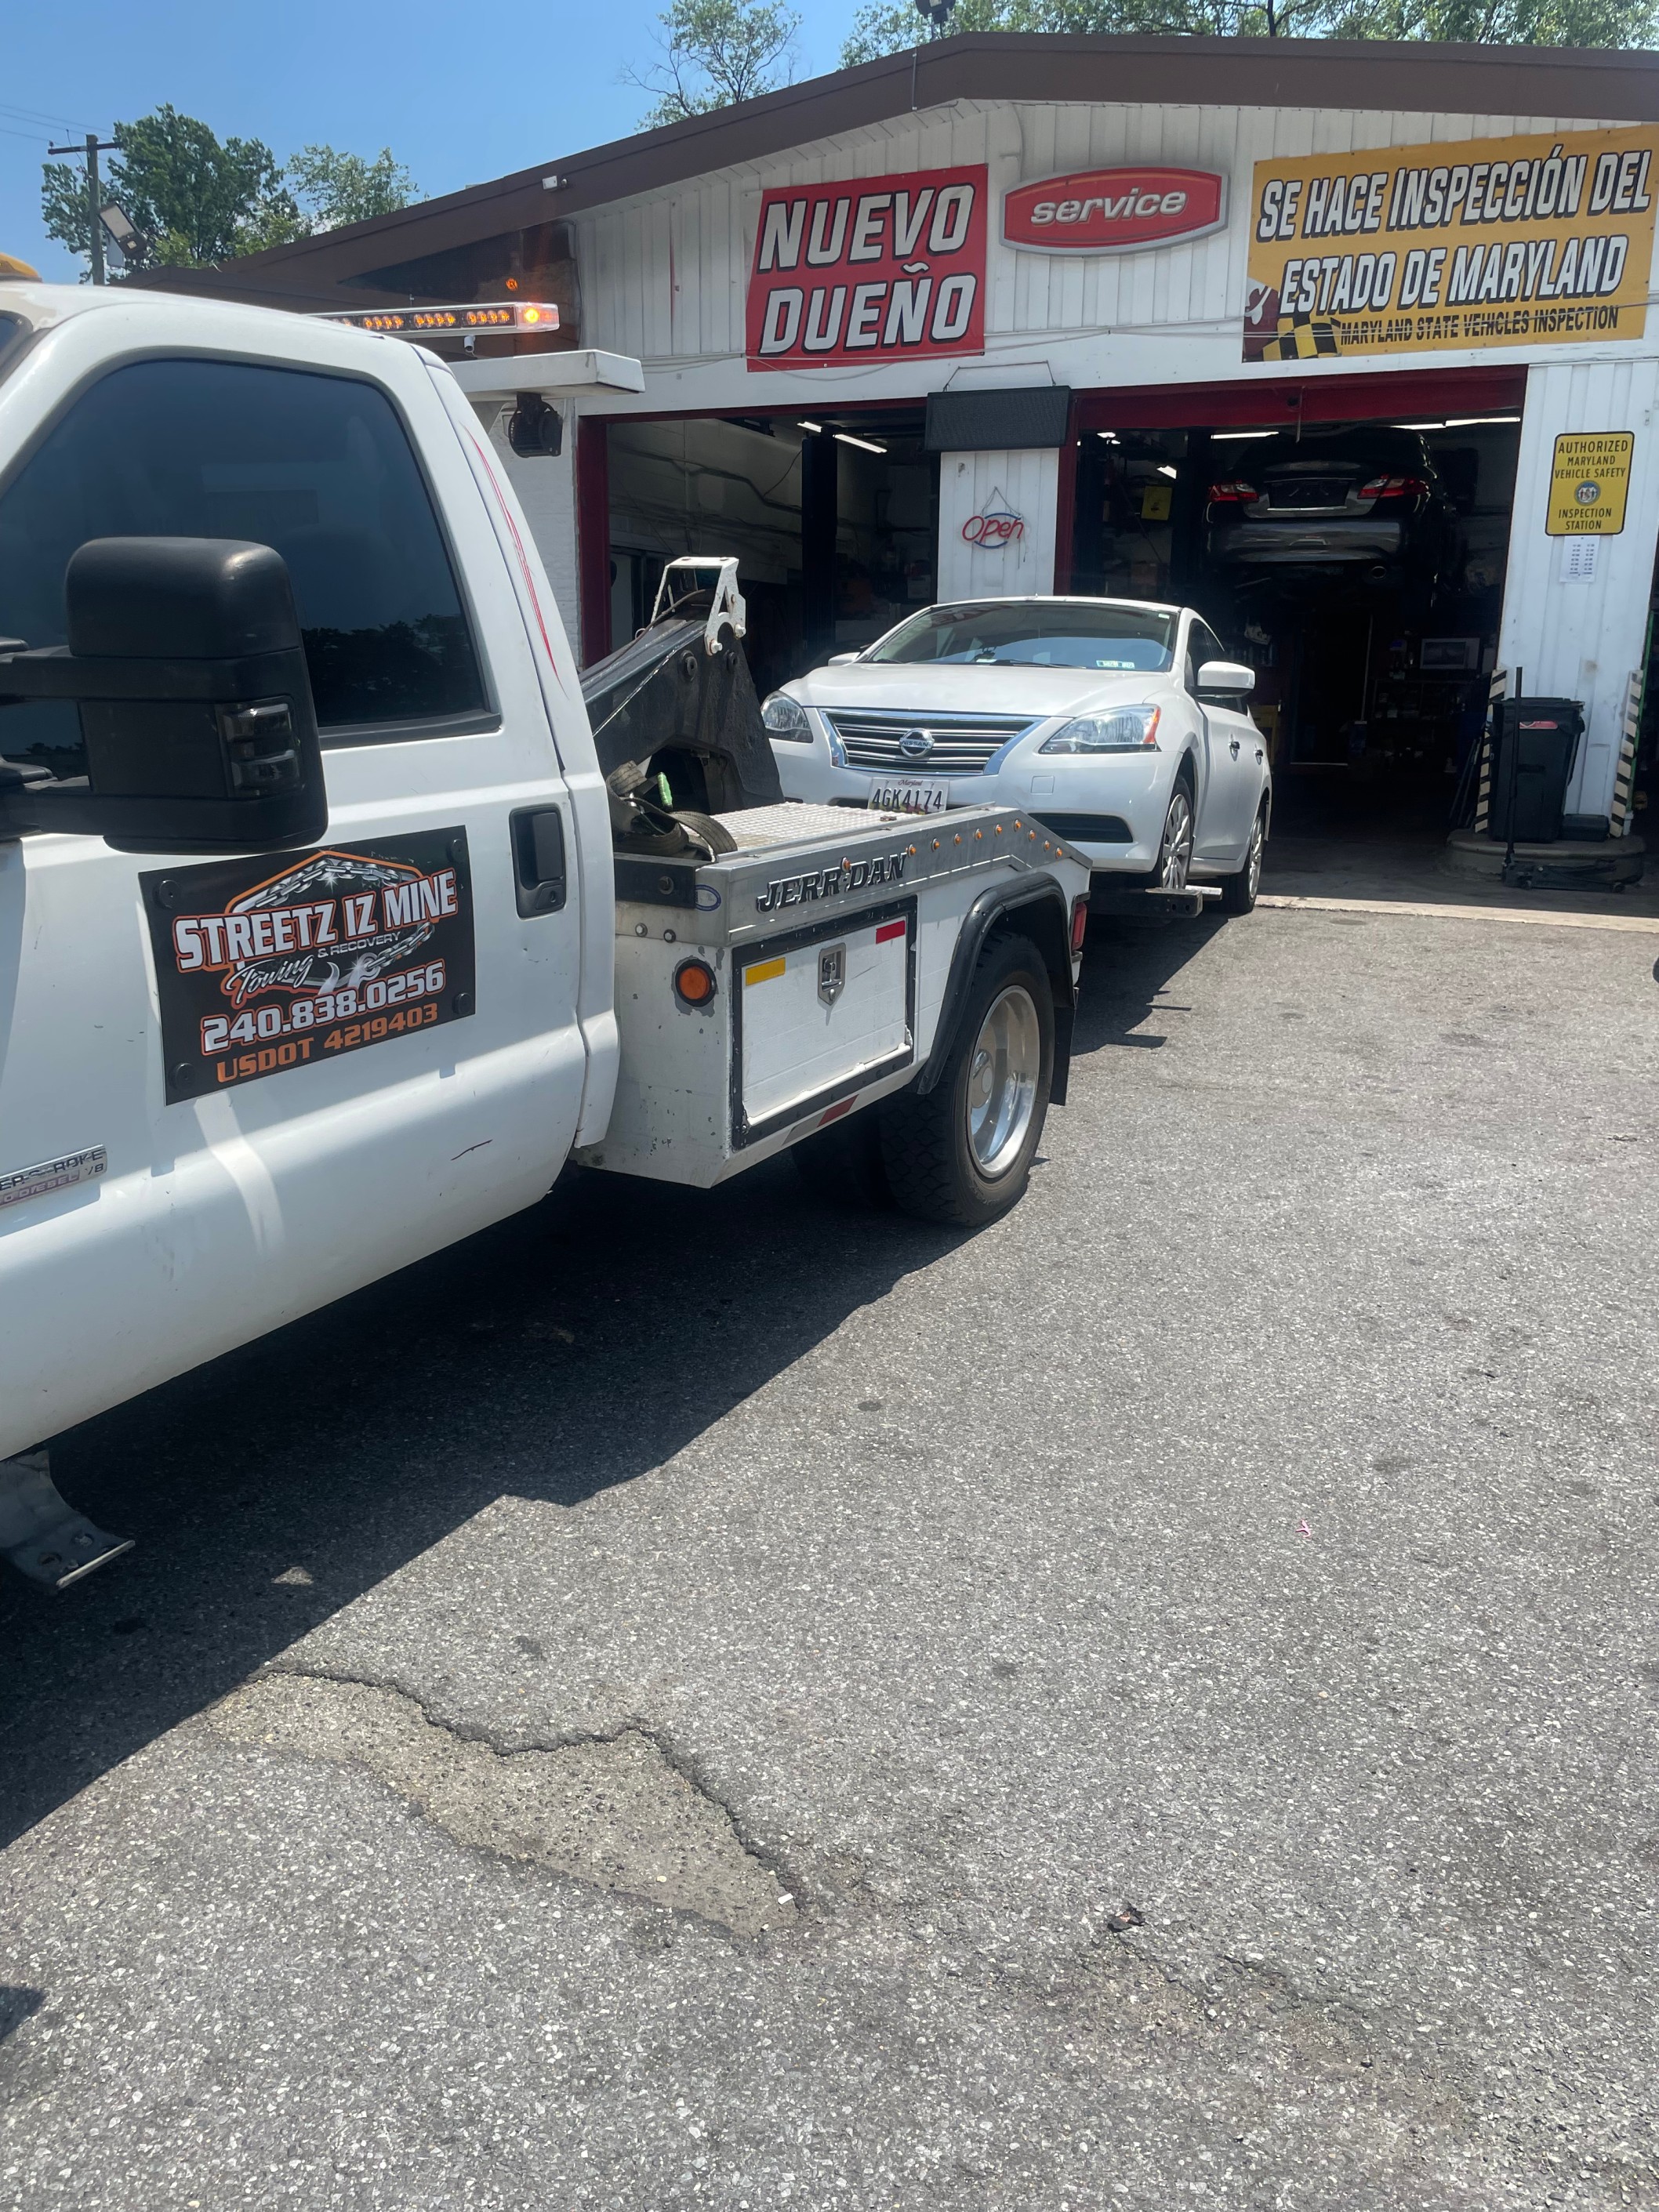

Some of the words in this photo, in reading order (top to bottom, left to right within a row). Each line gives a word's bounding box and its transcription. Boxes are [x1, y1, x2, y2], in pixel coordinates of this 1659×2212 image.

[1030, 187, 1187, 225] service
[1258, 179, 1301, 241] SE
[1303, 172, 1388, 237] HACE
[1388, 144, 1587, 230] INSPECCIÓN
[1589, 150, 1651, 215] DEL
[757, 183, 975, 272] NUEVO
[1280, 252, 1396, 314] ESTADO
[1398, 247, 1446, 309] DE
[1447, 235, 1628, 306] MARYLAND
[758, 263, 977, 354] DUEÑO
[1341, 318, 1412, 345] MARYLAND
[1416, 315, 1458, 340] STATE
[1463, 310, 1529, 337] VEHICLES
[1534, 305, 1619, 333] INSPECTION
[1558, 440, 1628, 454] AUTHORIZED
[1567, 455, 1615, 466] MARYLAND
[1555, 469, 1590, 479] VEHICLE
[1594, 468, 1625, 477] SAFETY
[962, 516, 1024, 543] Open
[1559, 508, 1611, 518] INSPECTION
[1565, 520, 1601, 530] STATION
[872, 788, 942, 810] 4GK4174
[174, 902, 336, 970] STREETZ
[344, 894, 376, 937] IZ
[384, 870, 457, 928] MINE
[318, 948, 329, 959] &
[330, 931, 401, 956] RECOVERY
[226, 954, 314, 1003] Towing
[203, 962, 445, 1052] 240.838.0256
[217, 1038, 314, 1082] USDOT
[324, 1003, 437, 1050] 4219403
